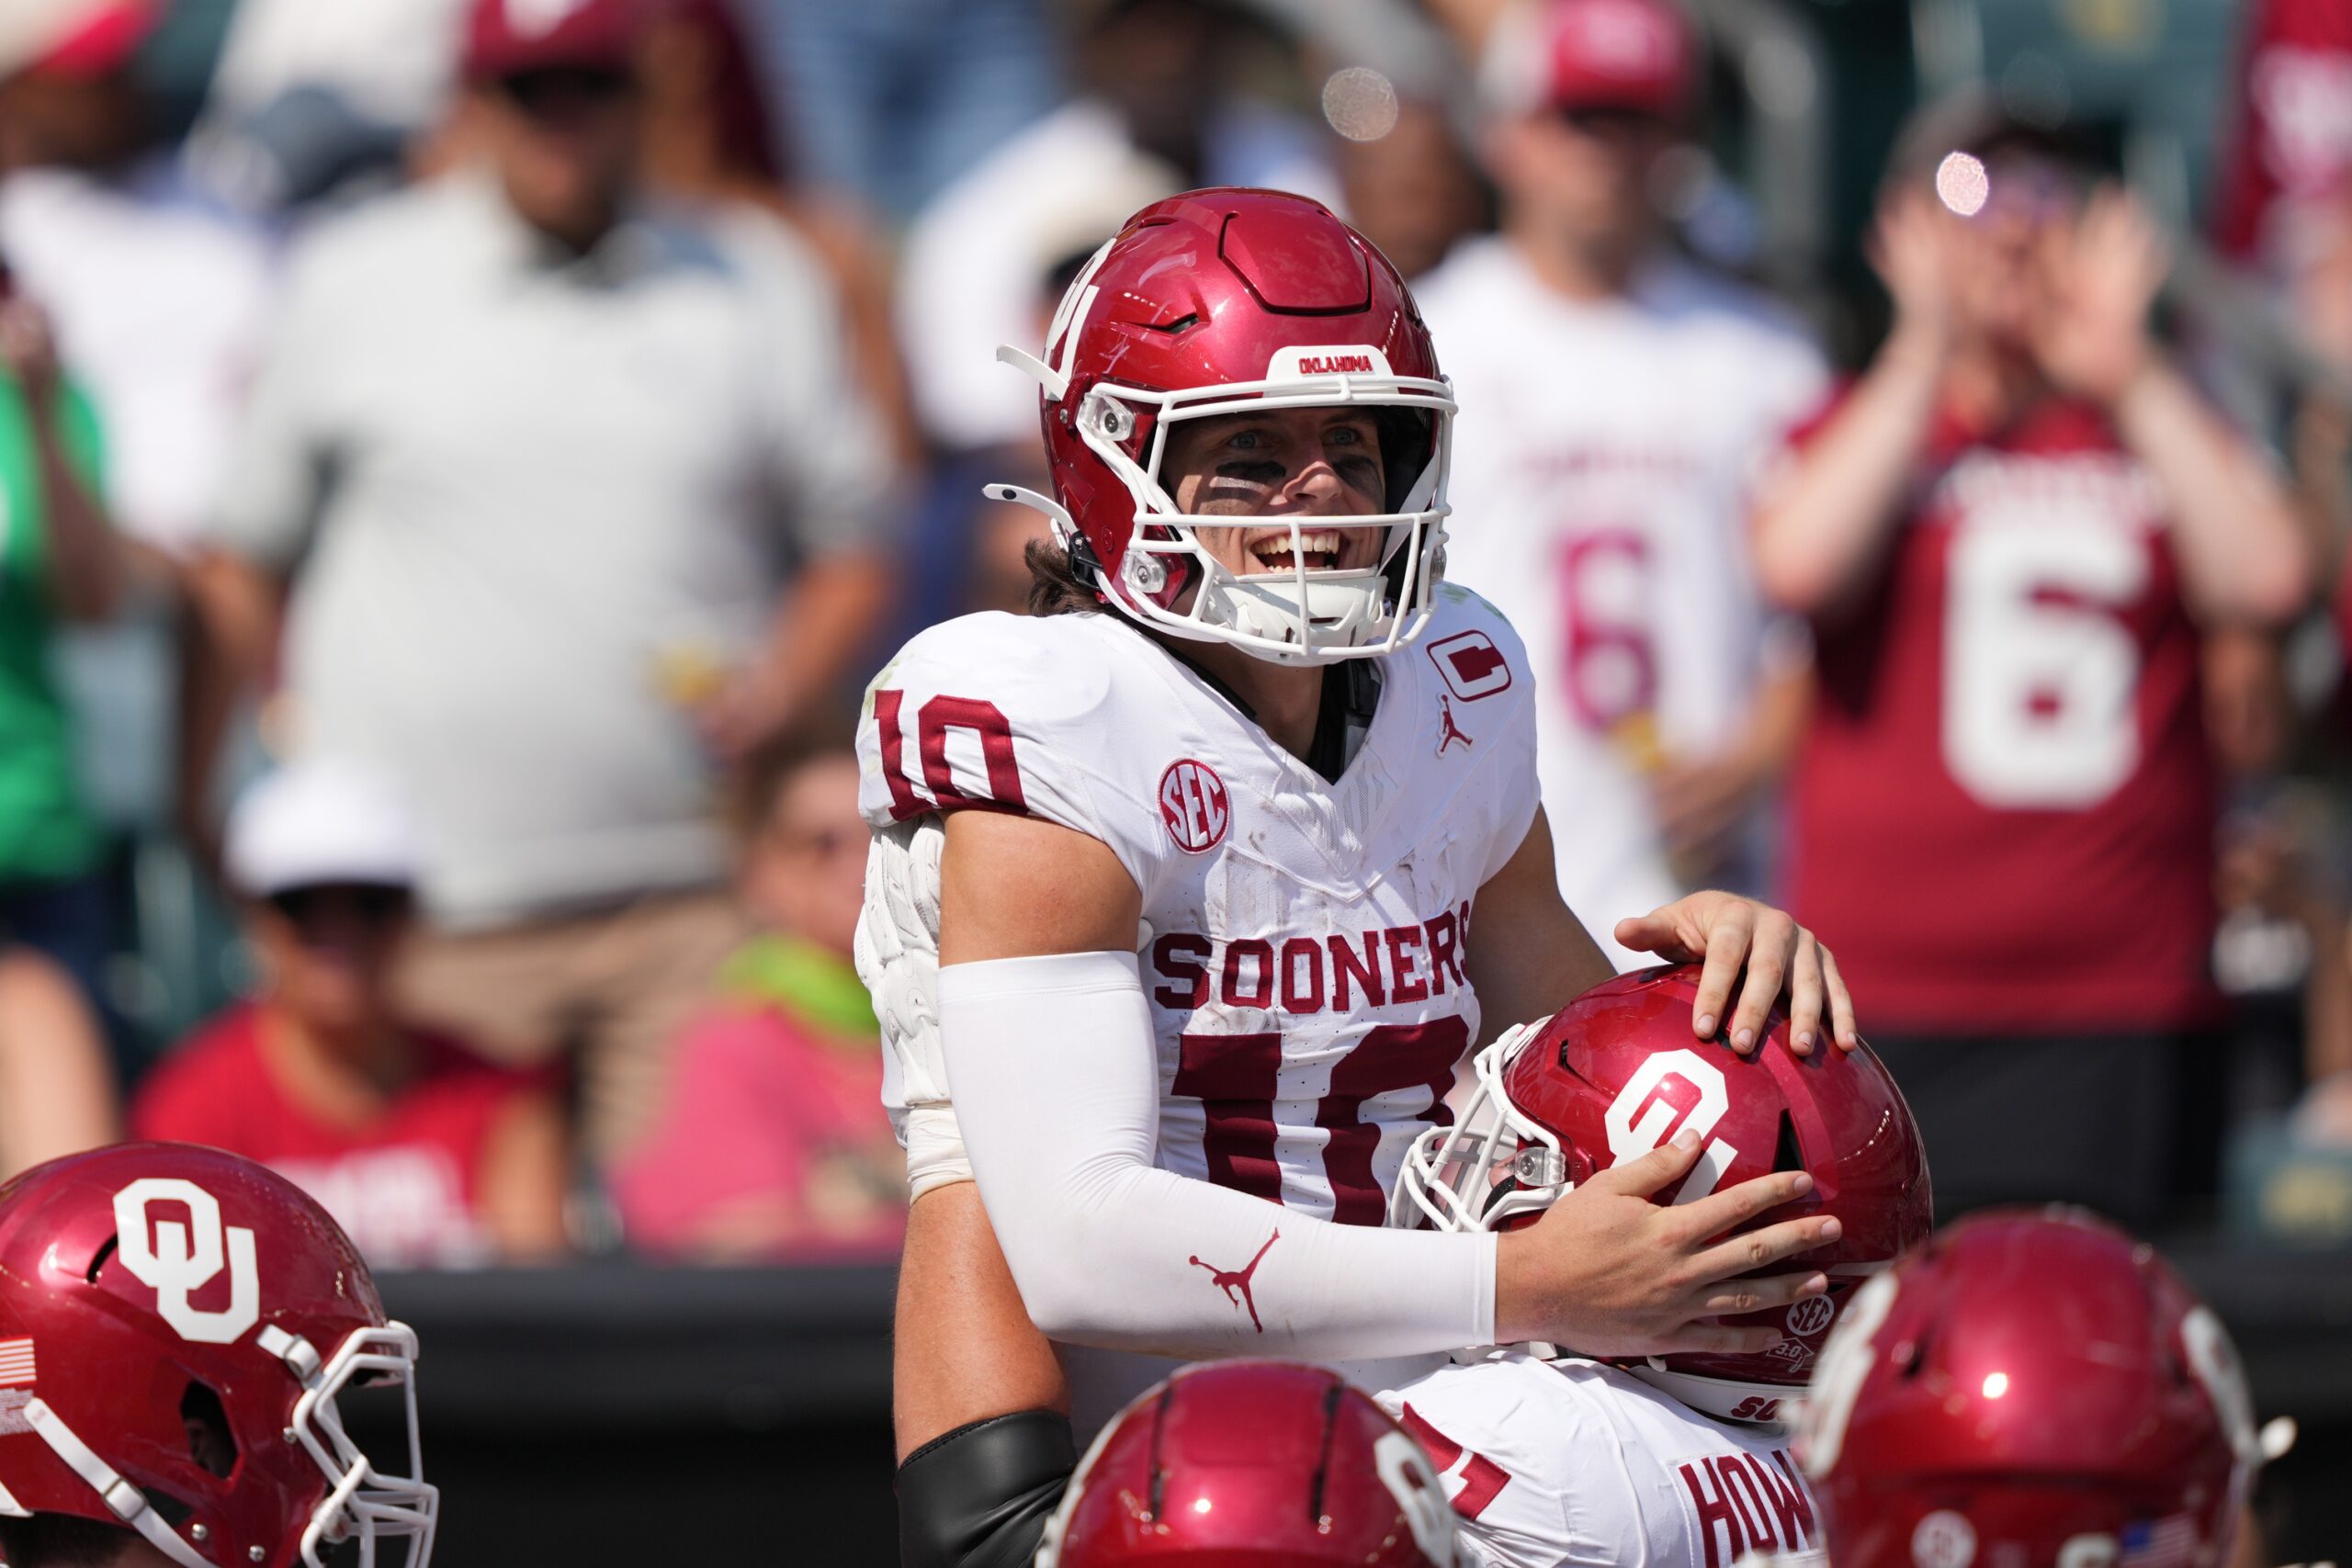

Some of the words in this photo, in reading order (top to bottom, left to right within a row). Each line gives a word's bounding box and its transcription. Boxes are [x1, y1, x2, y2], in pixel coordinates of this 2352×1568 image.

[1297, 355, 1374, 374] OKLAHOMA
[1943, 505, 2151, 809] 6
[873, 688, 1029, 822] 10
[1162, 761, 1225, 849] SEC
[112, 1177, 260, 1345] OU
[1790, 1295, 1831, 1333] SEC
[1678, 1448, 1816, 1568] HOW
